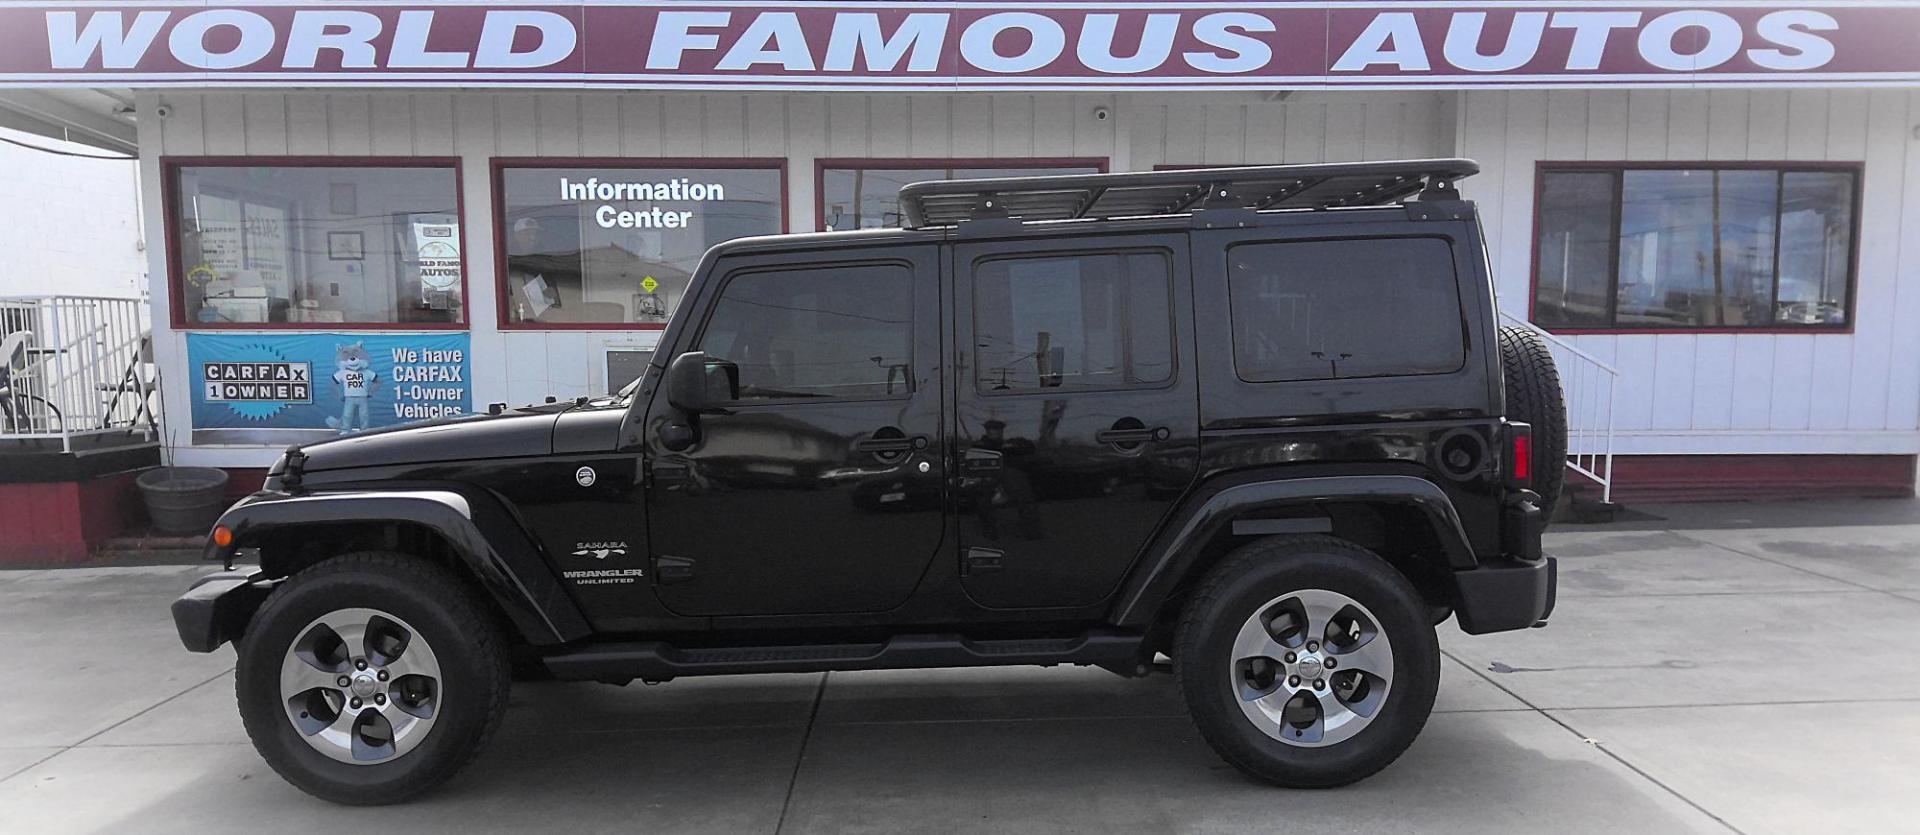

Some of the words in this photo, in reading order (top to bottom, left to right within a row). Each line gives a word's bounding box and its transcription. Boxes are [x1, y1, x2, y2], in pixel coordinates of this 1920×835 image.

[46, 9, 577, 69] WORLD
[645, 11, 1277, 73] FAMOUS
[1330, 9, 1840, 72] AUTOS
[560, 178, 724, 201] Information
[596, 205, 692, 228] Center
[420, 268, 459, 277] AUTOS
[392, 347, 418, 363] We
[423, 347, 464, 363] have
[206, 364, 305, 381] CARFAX
[346, 373, 364, 381] CAR
[393, 366, 463, 382] CARFAX
[209, 384, 220, 398] 1
[225, 385, 306, 398] OWNER
[347, 381, 364, 389] FOX
[393, 384, 464, 400] 1-Owner
[393, 402, 462, 418] Vehicles
[576, 541, 628, 549] SAHARA
[563, 568, 644, 579] WRANGLER
[576, 578, 635, 586] UNLIMITED
